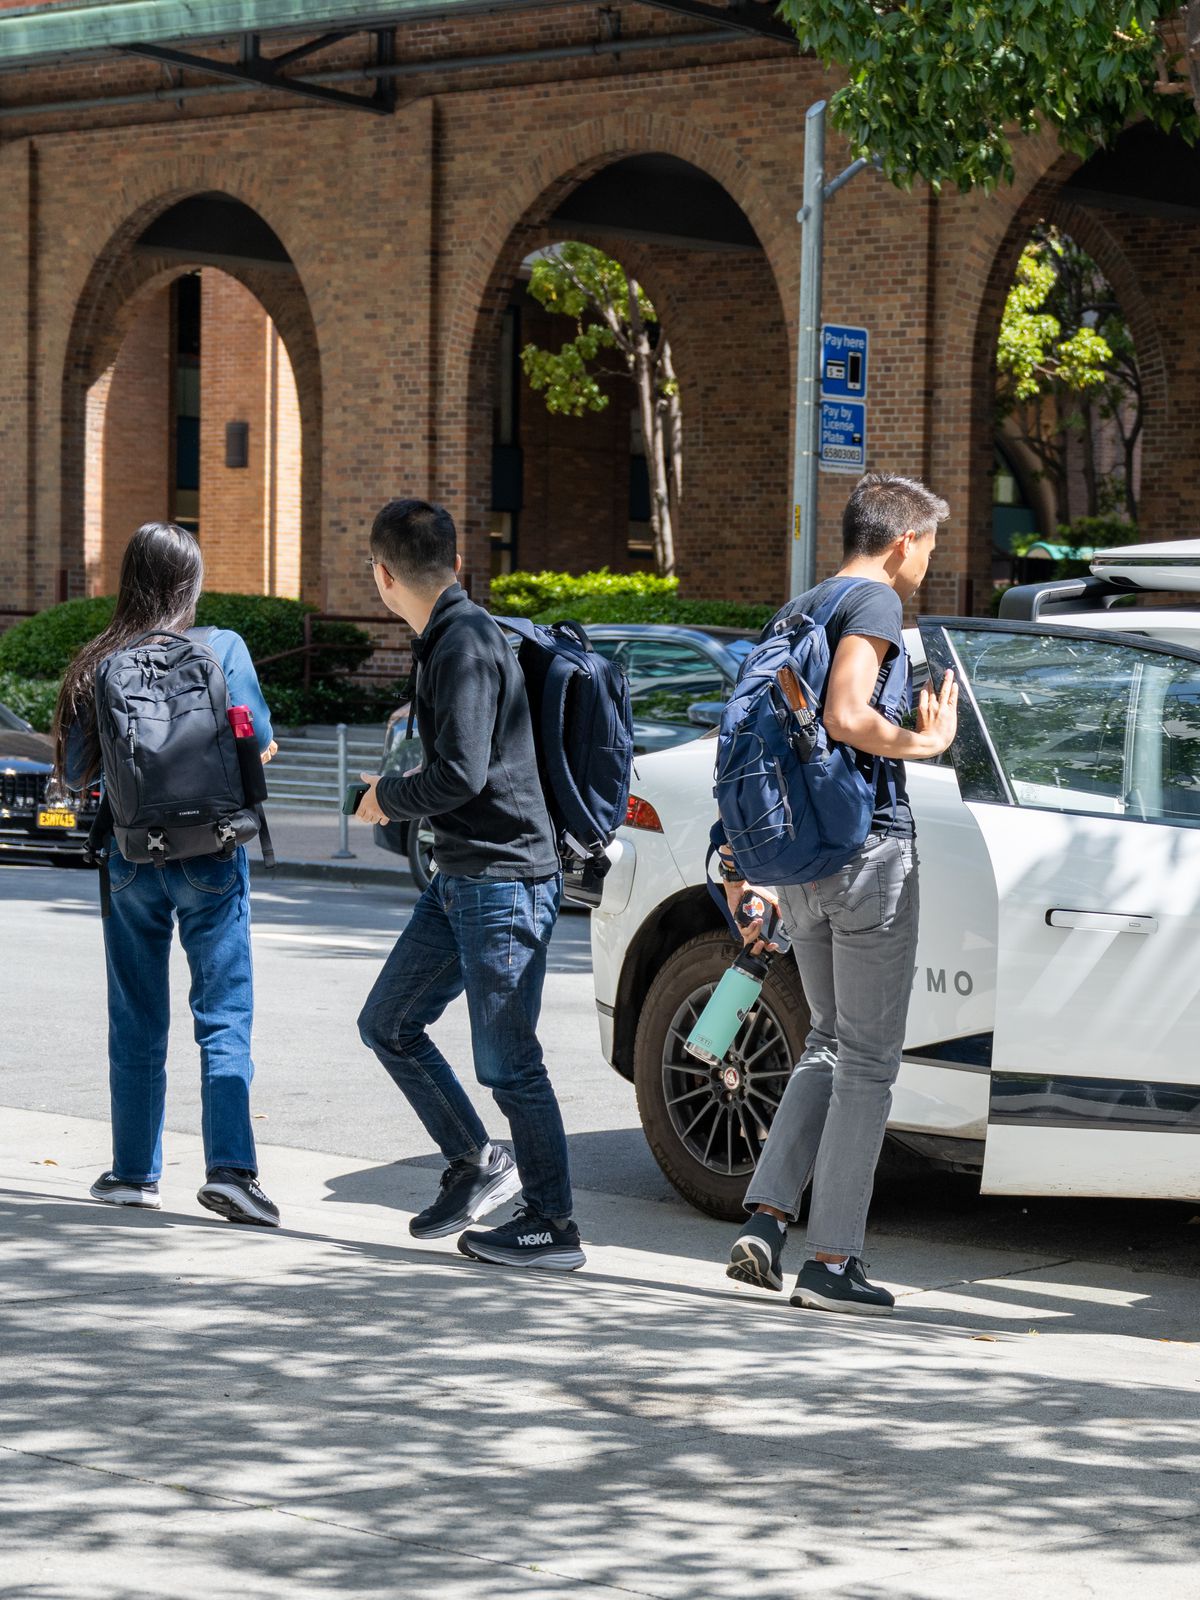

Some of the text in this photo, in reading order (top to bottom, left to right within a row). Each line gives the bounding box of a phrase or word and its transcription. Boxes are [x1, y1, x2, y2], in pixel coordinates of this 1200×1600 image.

[824, 332, 865, 350] Pay here
[823, 404, 852, 420] Pay by
[823, 418, 854, 432] License
[823, 431, 845, 443] Plate
[517, 1232, 553, 1246] HOKA
